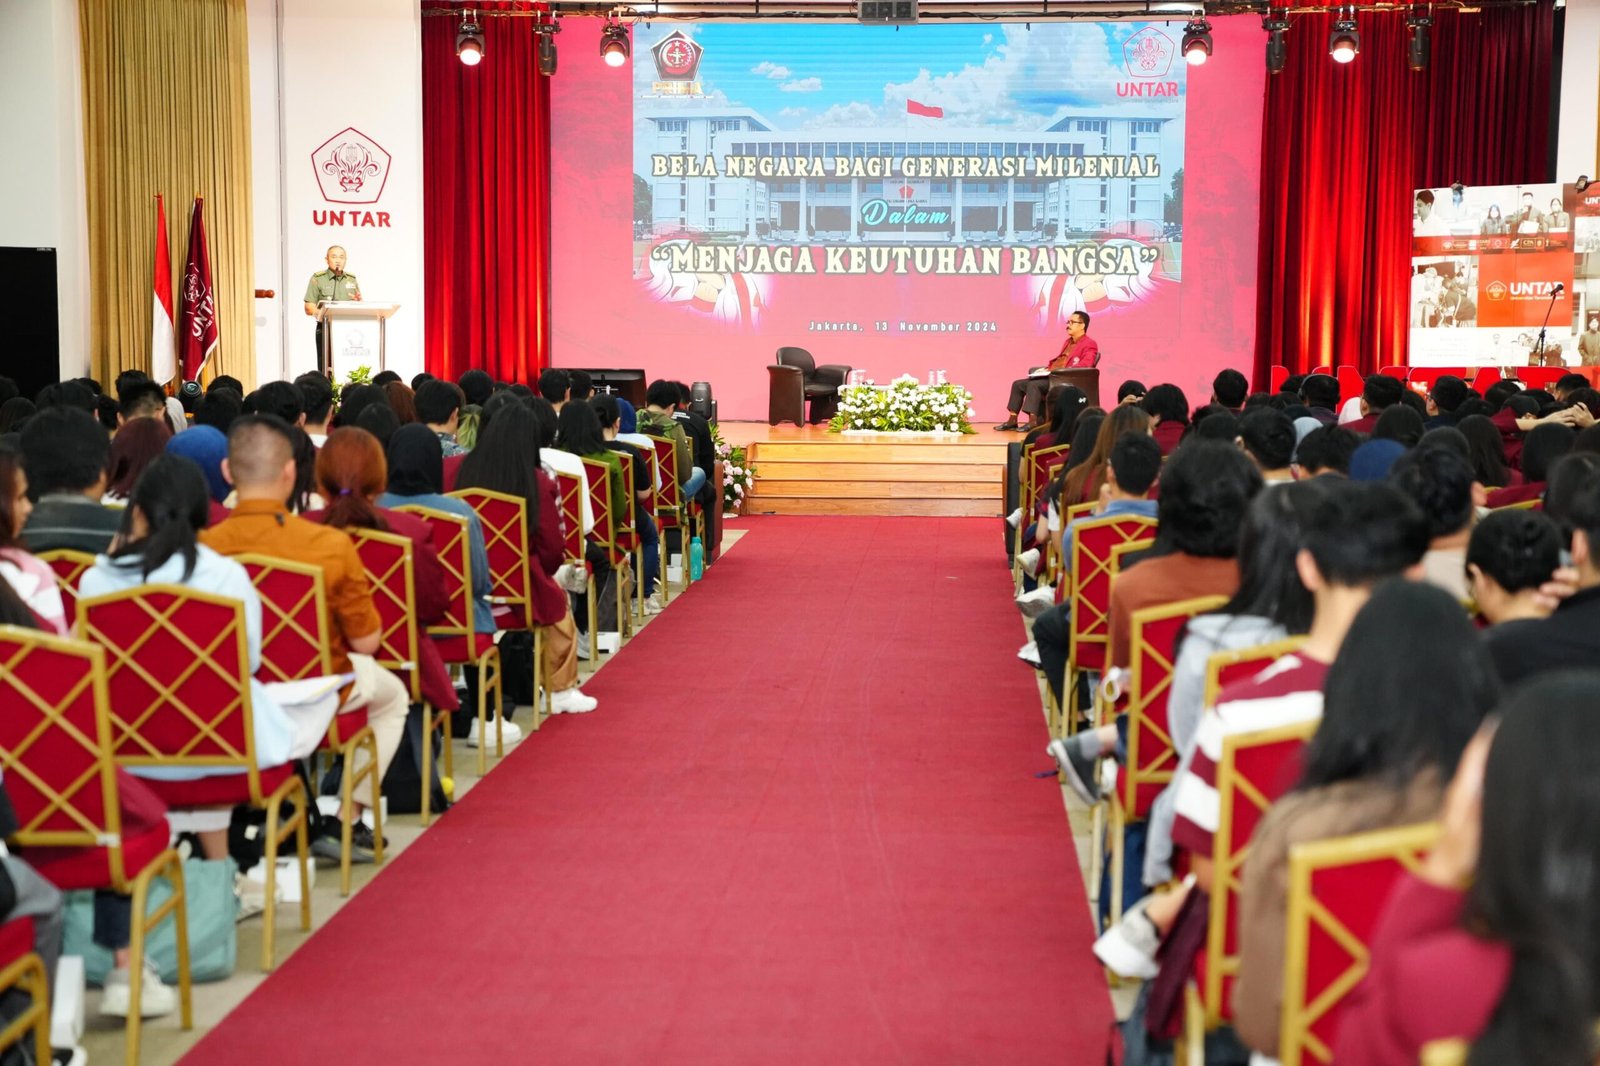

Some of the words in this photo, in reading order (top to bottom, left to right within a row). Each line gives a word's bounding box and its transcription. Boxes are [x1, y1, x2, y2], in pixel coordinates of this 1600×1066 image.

[1116, 82, 1179, 97] UNTAR
[652, 155, 718, 177] BELA
[725, 156, 827, 178] NEGARA
[835, 156, 893, 178] BAGI
[901, 155, 1026, 178] GENERASI
[1034, 154, 1160, 178] MILENIAL
[313, 210, 391, 228] UNTAR
[862, 199, 950, 226] Dalam
[652, 241, 816, 274] “MENJAGA
[825, 246, 1001, 274] KEUTUHAN
[1012, 246, 1159, 275] BANGSA”
[809, 321, 865, 333] Jakarta,
[875, 321, 888, 331] 13
[900, 321, 960, 332] November
[967, 321, 997, 332] 2024
